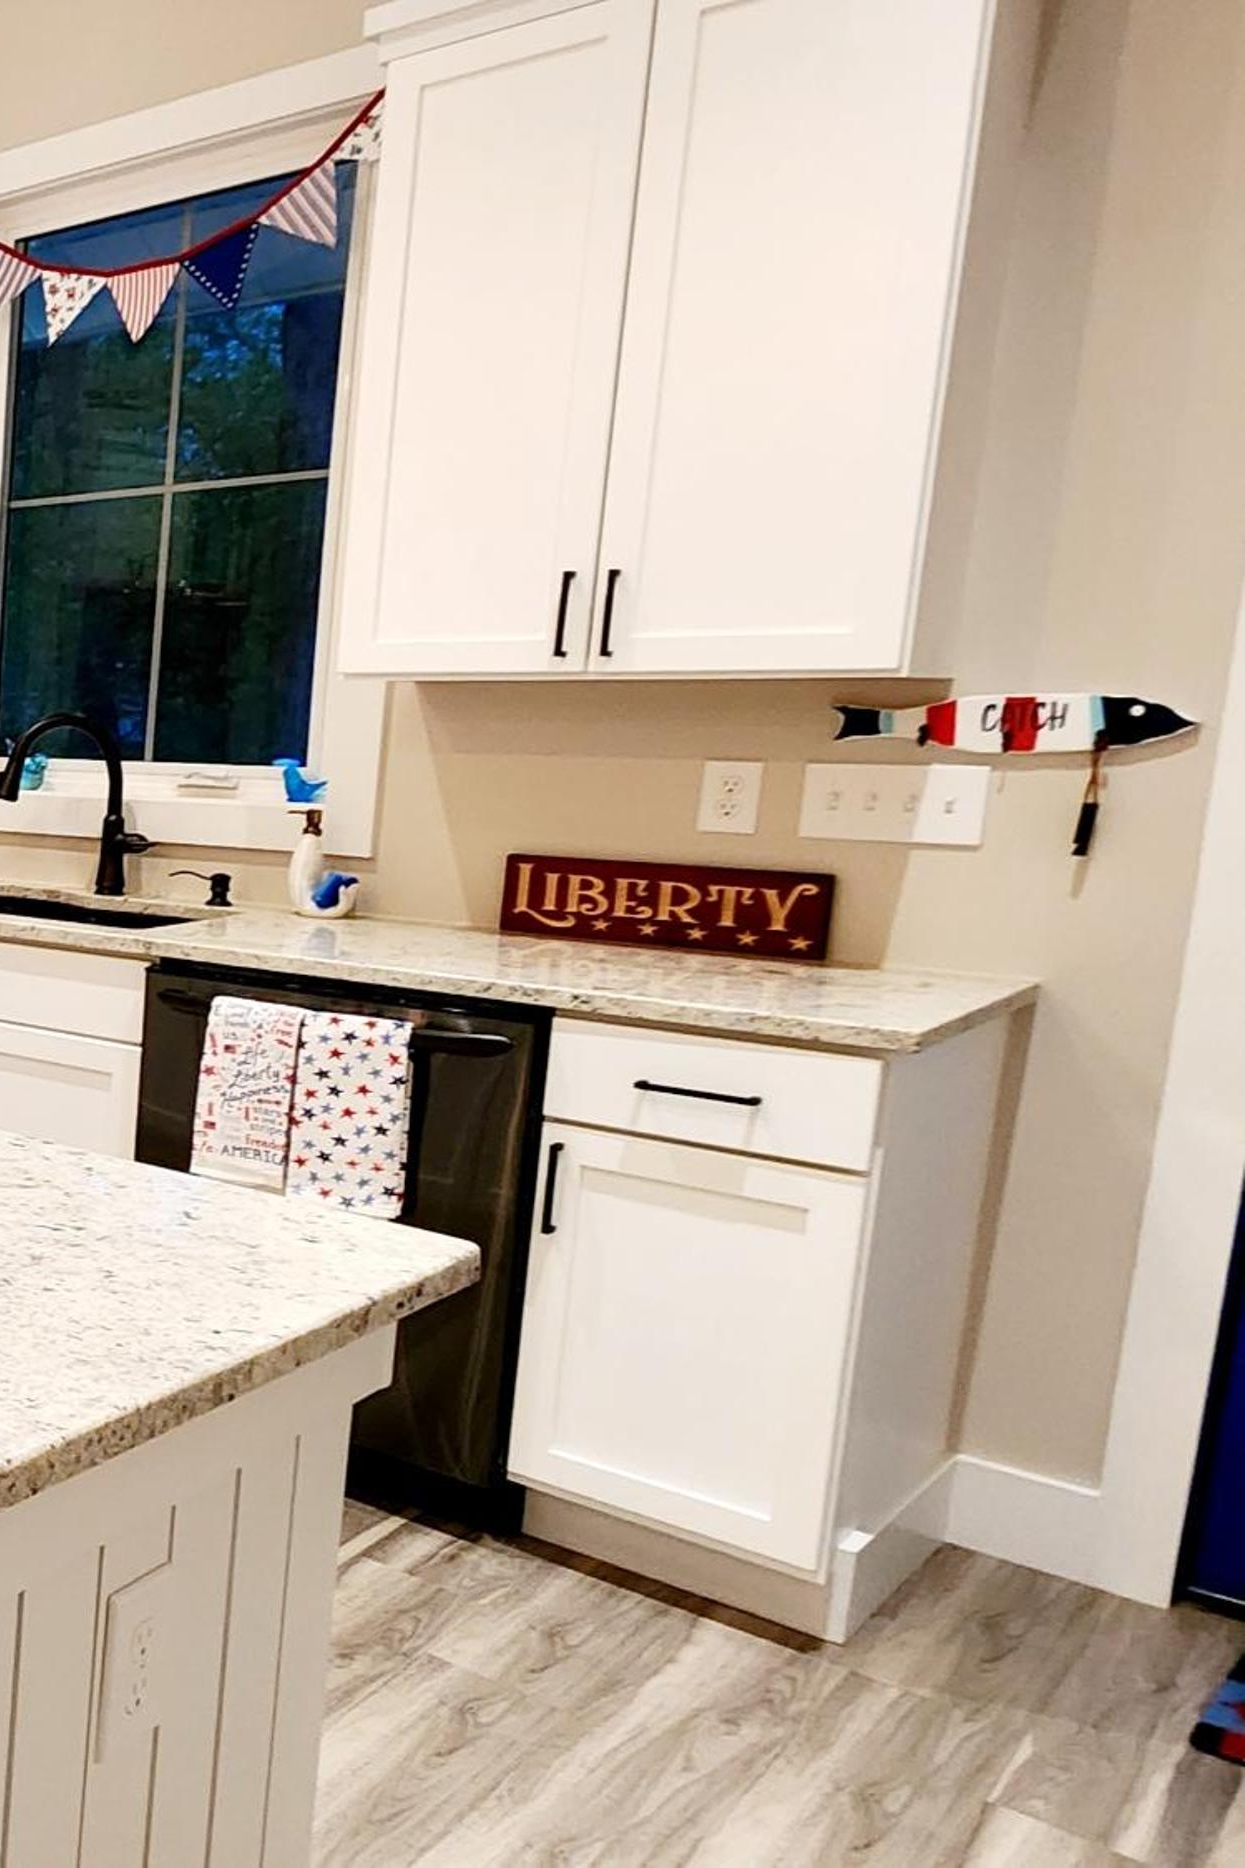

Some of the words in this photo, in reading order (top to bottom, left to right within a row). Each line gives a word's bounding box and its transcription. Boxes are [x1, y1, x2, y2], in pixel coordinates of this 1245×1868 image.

[981, 701, 1069, 732] CATCH
[513, 863, 819, 931] LIBERTY
[220, 1145, 287, 1167] AMERICA
